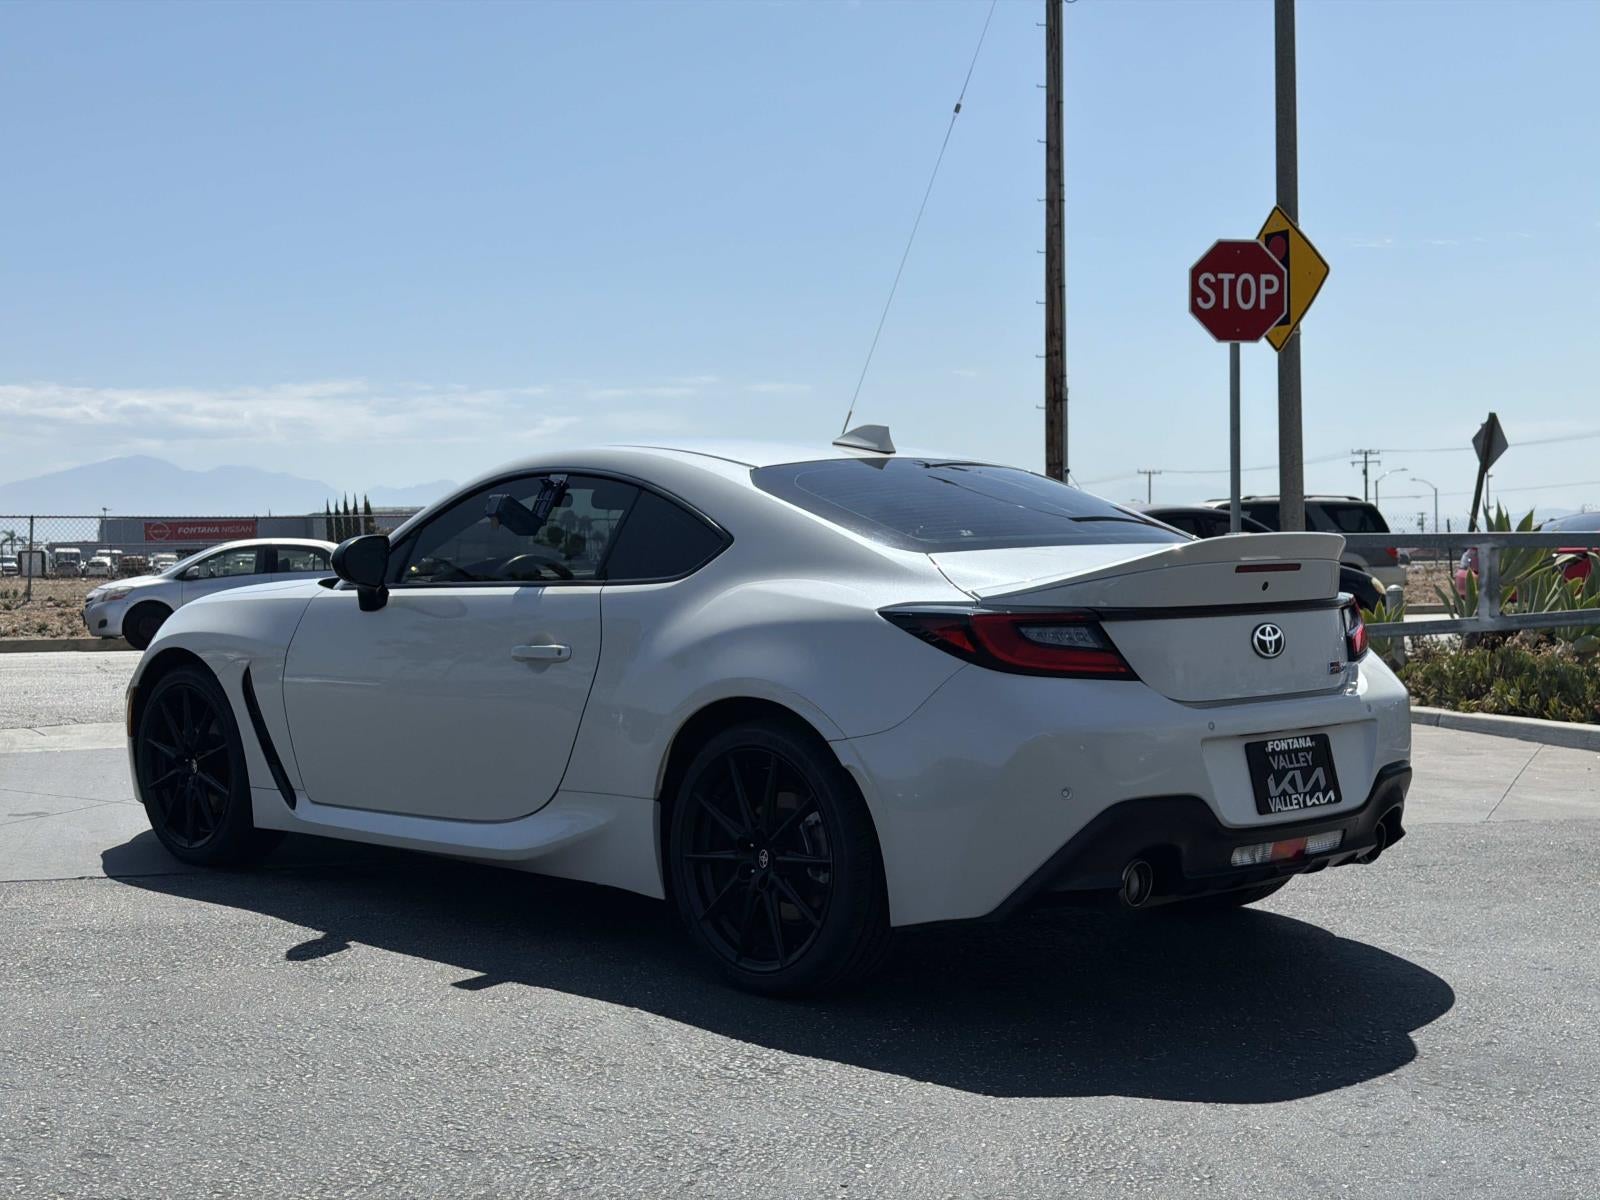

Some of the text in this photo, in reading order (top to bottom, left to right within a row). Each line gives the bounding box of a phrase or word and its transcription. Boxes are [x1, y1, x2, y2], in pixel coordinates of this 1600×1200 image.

[1197, 272, 1280, 310] STOP
[177, 525, 252, 535] FONTANA NISSAN
[1267, 736, 1313, 752] FONTANA
[1268, 751, 1313, 770] VALLEY
[1268, 793, 1304, 812] VALLEY
